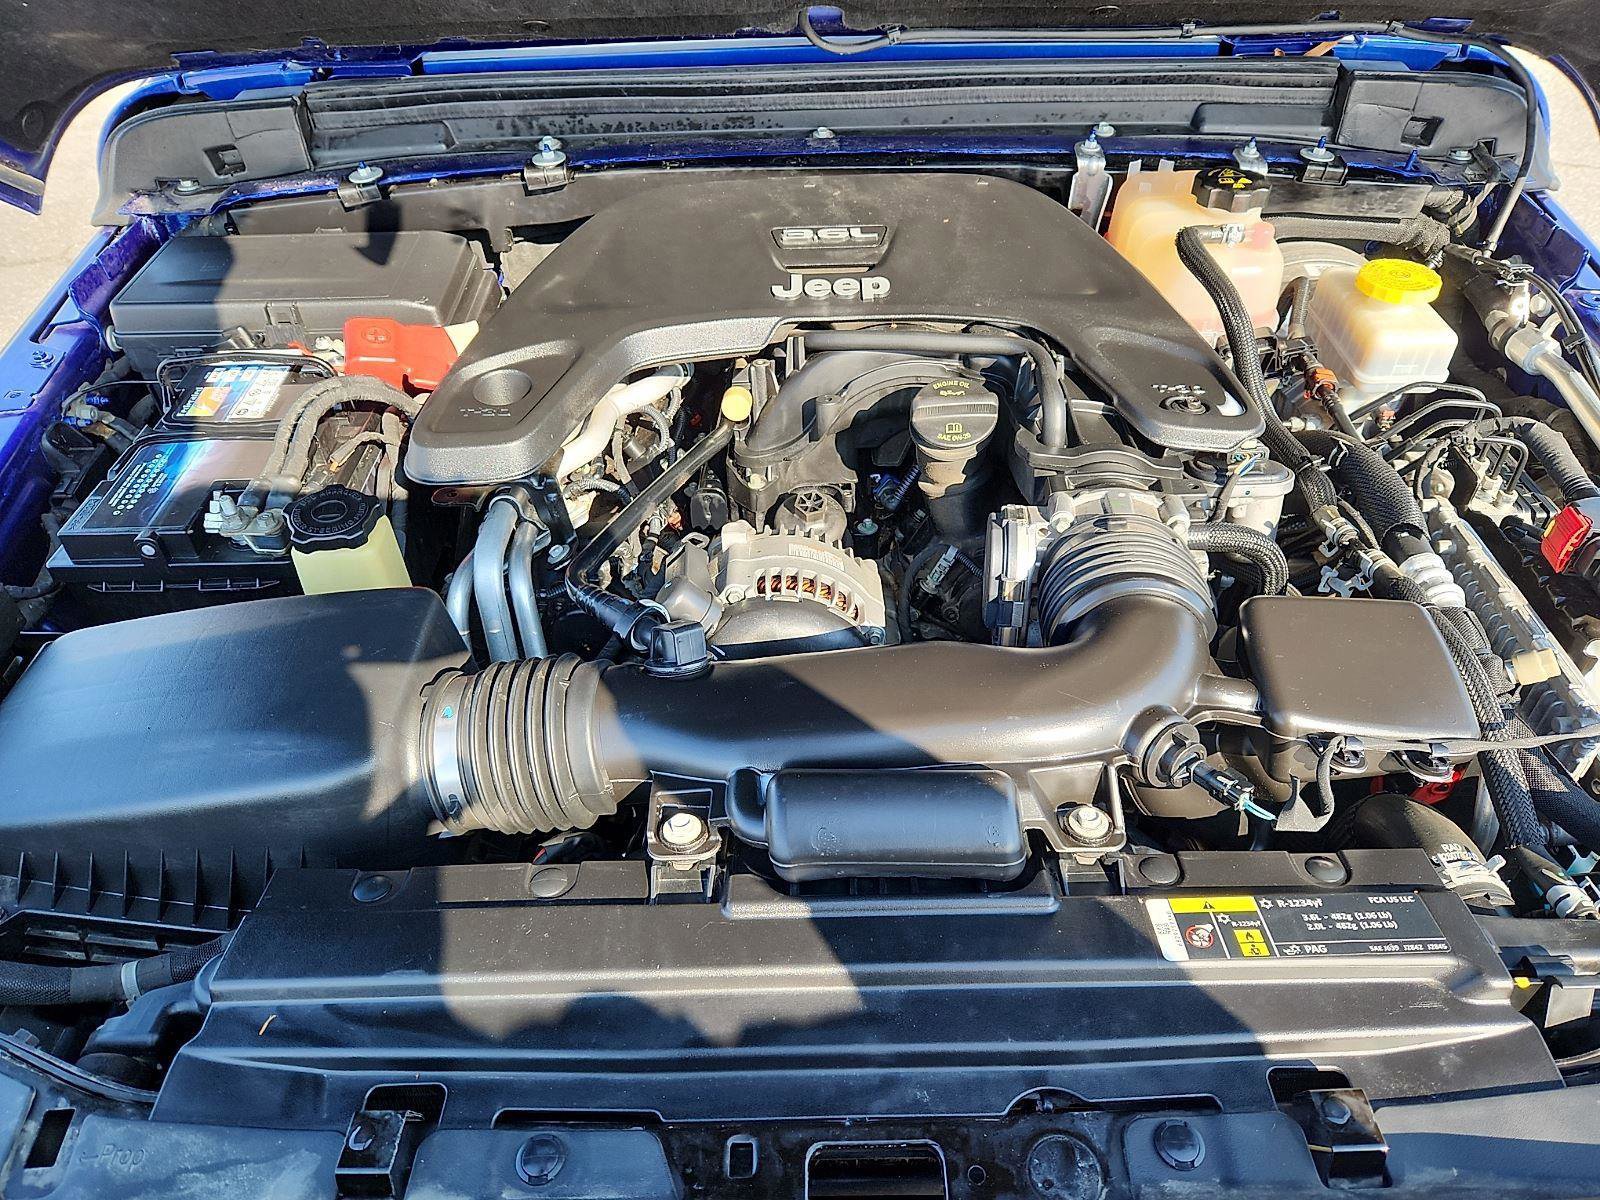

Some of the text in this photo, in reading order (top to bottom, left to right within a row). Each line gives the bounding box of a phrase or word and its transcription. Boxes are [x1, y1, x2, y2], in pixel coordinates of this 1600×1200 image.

[770, 274, 891, 302] Jeep
[932, 380, 970, 389] ENGINE OIL
[1276, 897, 1323, 909] R-1234yf
[1367, 895, 1416, 904] FCA US LLC
[1301, 913, 1322, 922] 3.6L
[1330, 912, 1353, 921] 482g
[1354, 911, 1378, 920] (1.06
[1231, 920, 1261, 928] R-1234yf
[1306, 922, 1327, 931] 2.0L
[1335, 922, 1359, 931] 482g
[1360, 921, 1383, 930] (1.06
[1303, 944, 1328, 954] PAG
